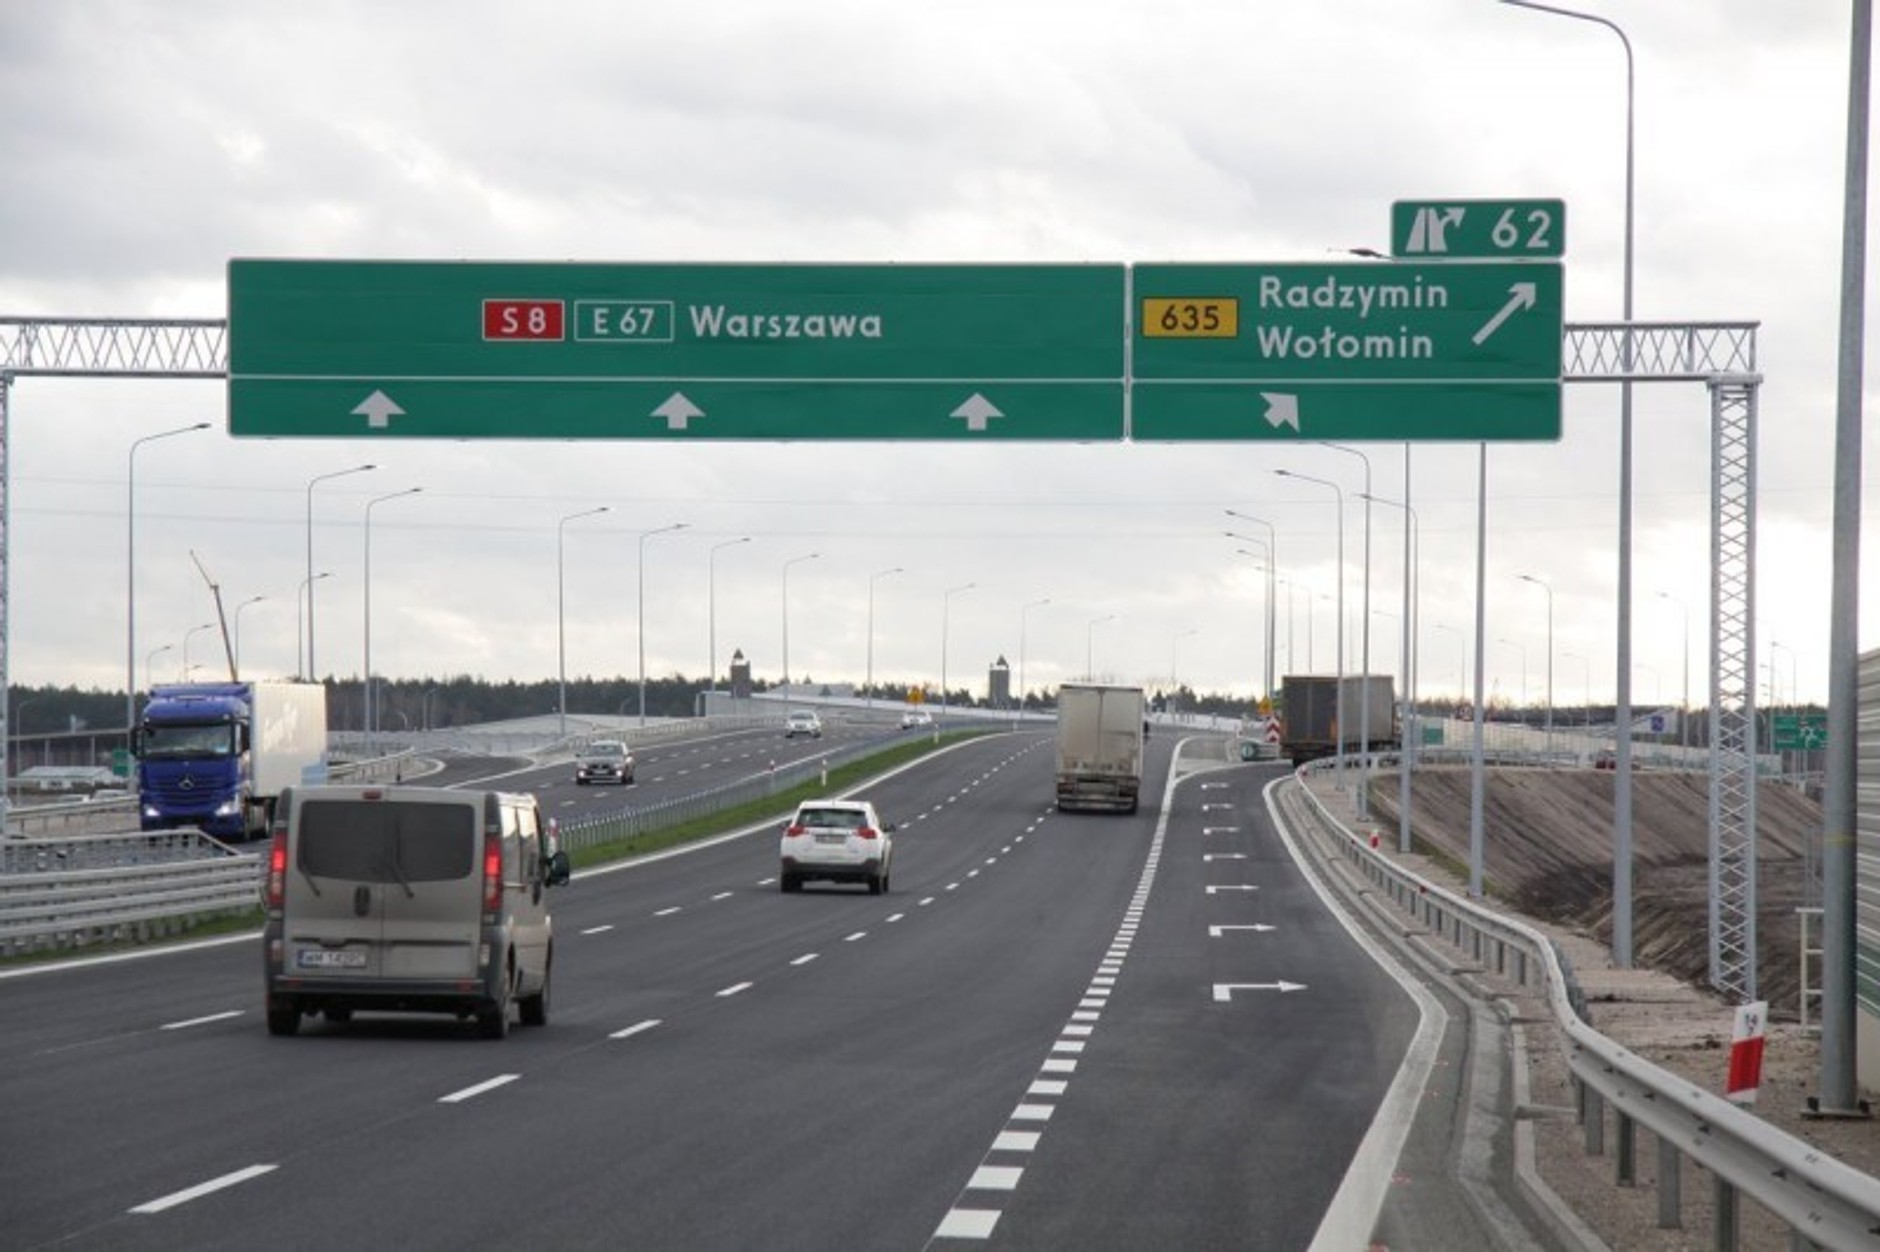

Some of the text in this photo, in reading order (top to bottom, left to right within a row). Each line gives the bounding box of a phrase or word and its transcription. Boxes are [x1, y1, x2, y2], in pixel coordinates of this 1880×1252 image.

[1491, 208, 1551, 248] 62
[1259, 275, 1448, 318] Radzymin
[501, 307, 547, 334] S 8
[594, 307, 655, 334] E 67
[689, 305, 882, 338] Warszawa
[1160, 304, 1220, 332] 635
[1257, 326, 1433, 358] Wołomin
